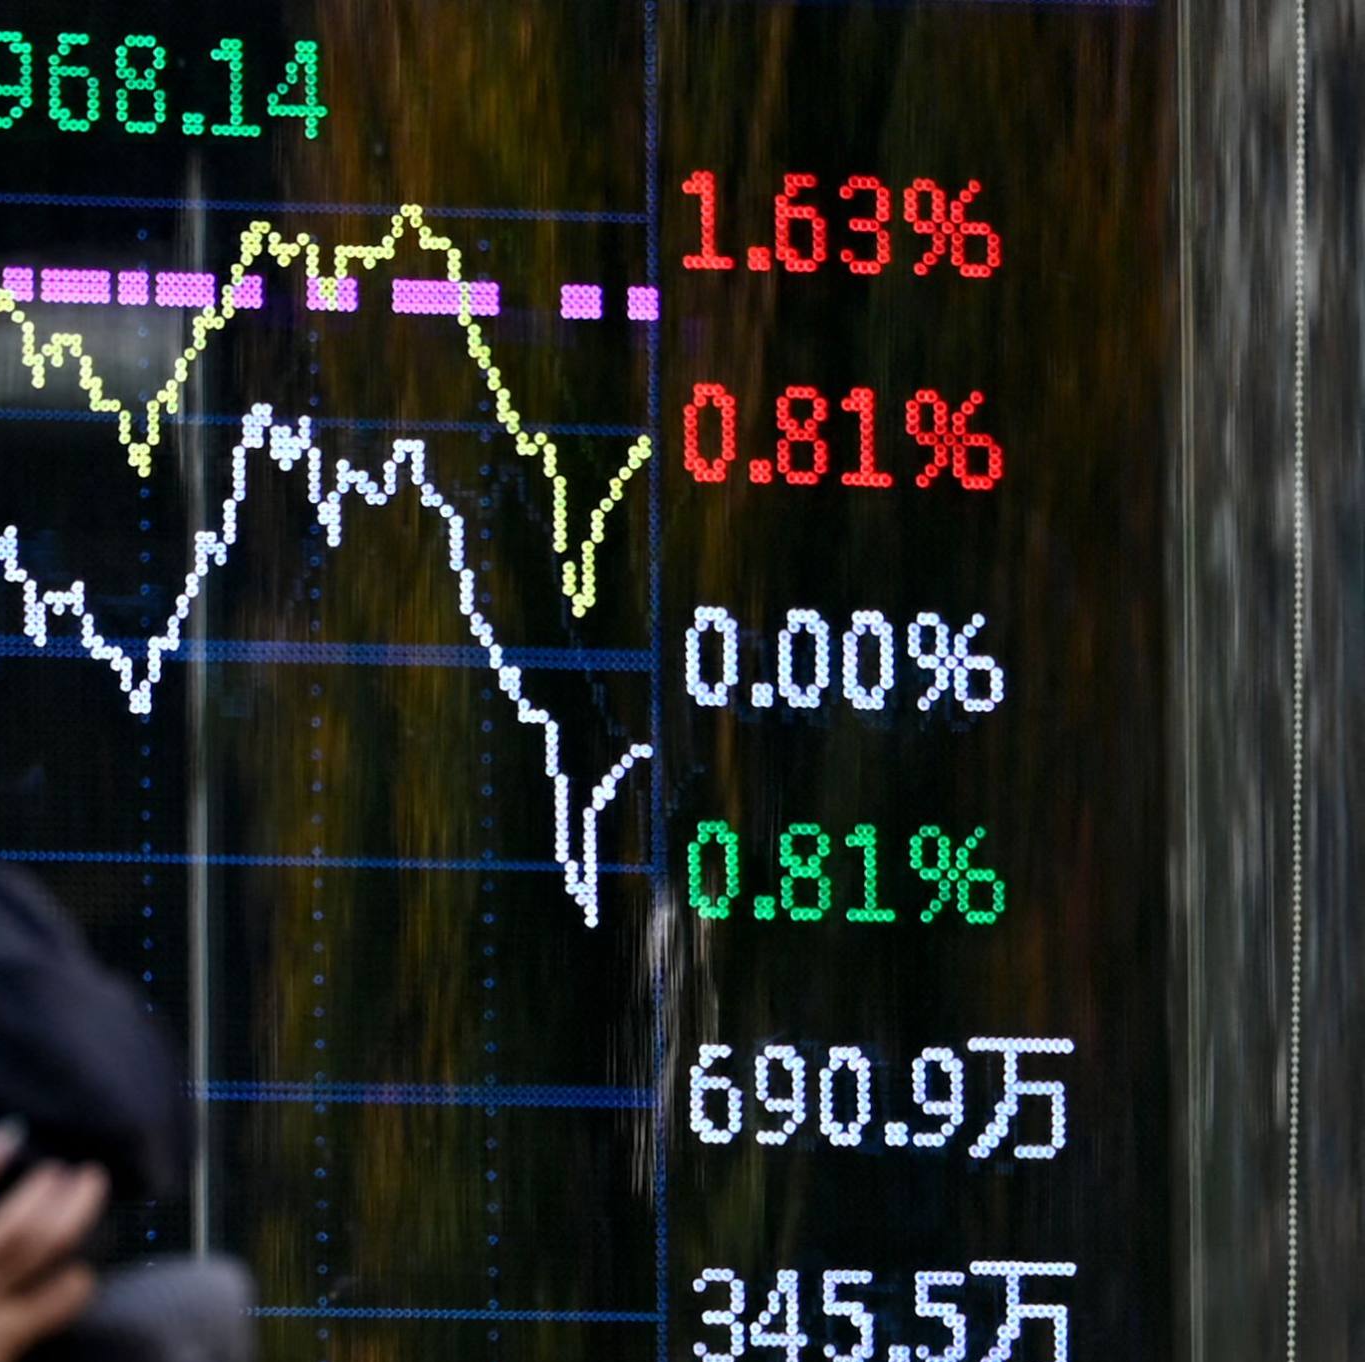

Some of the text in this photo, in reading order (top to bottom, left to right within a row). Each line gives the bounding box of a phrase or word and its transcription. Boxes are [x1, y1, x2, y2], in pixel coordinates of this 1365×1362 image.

[680, 169, 1003, 280] 1.63%
[682, 381, 1004, 492] 0.81%
[685, 605, 1005, 713] 0.00%
[687, 819, 1006, 926] 0.81%
[688, 1036, 1075, 1160] 690.9万
